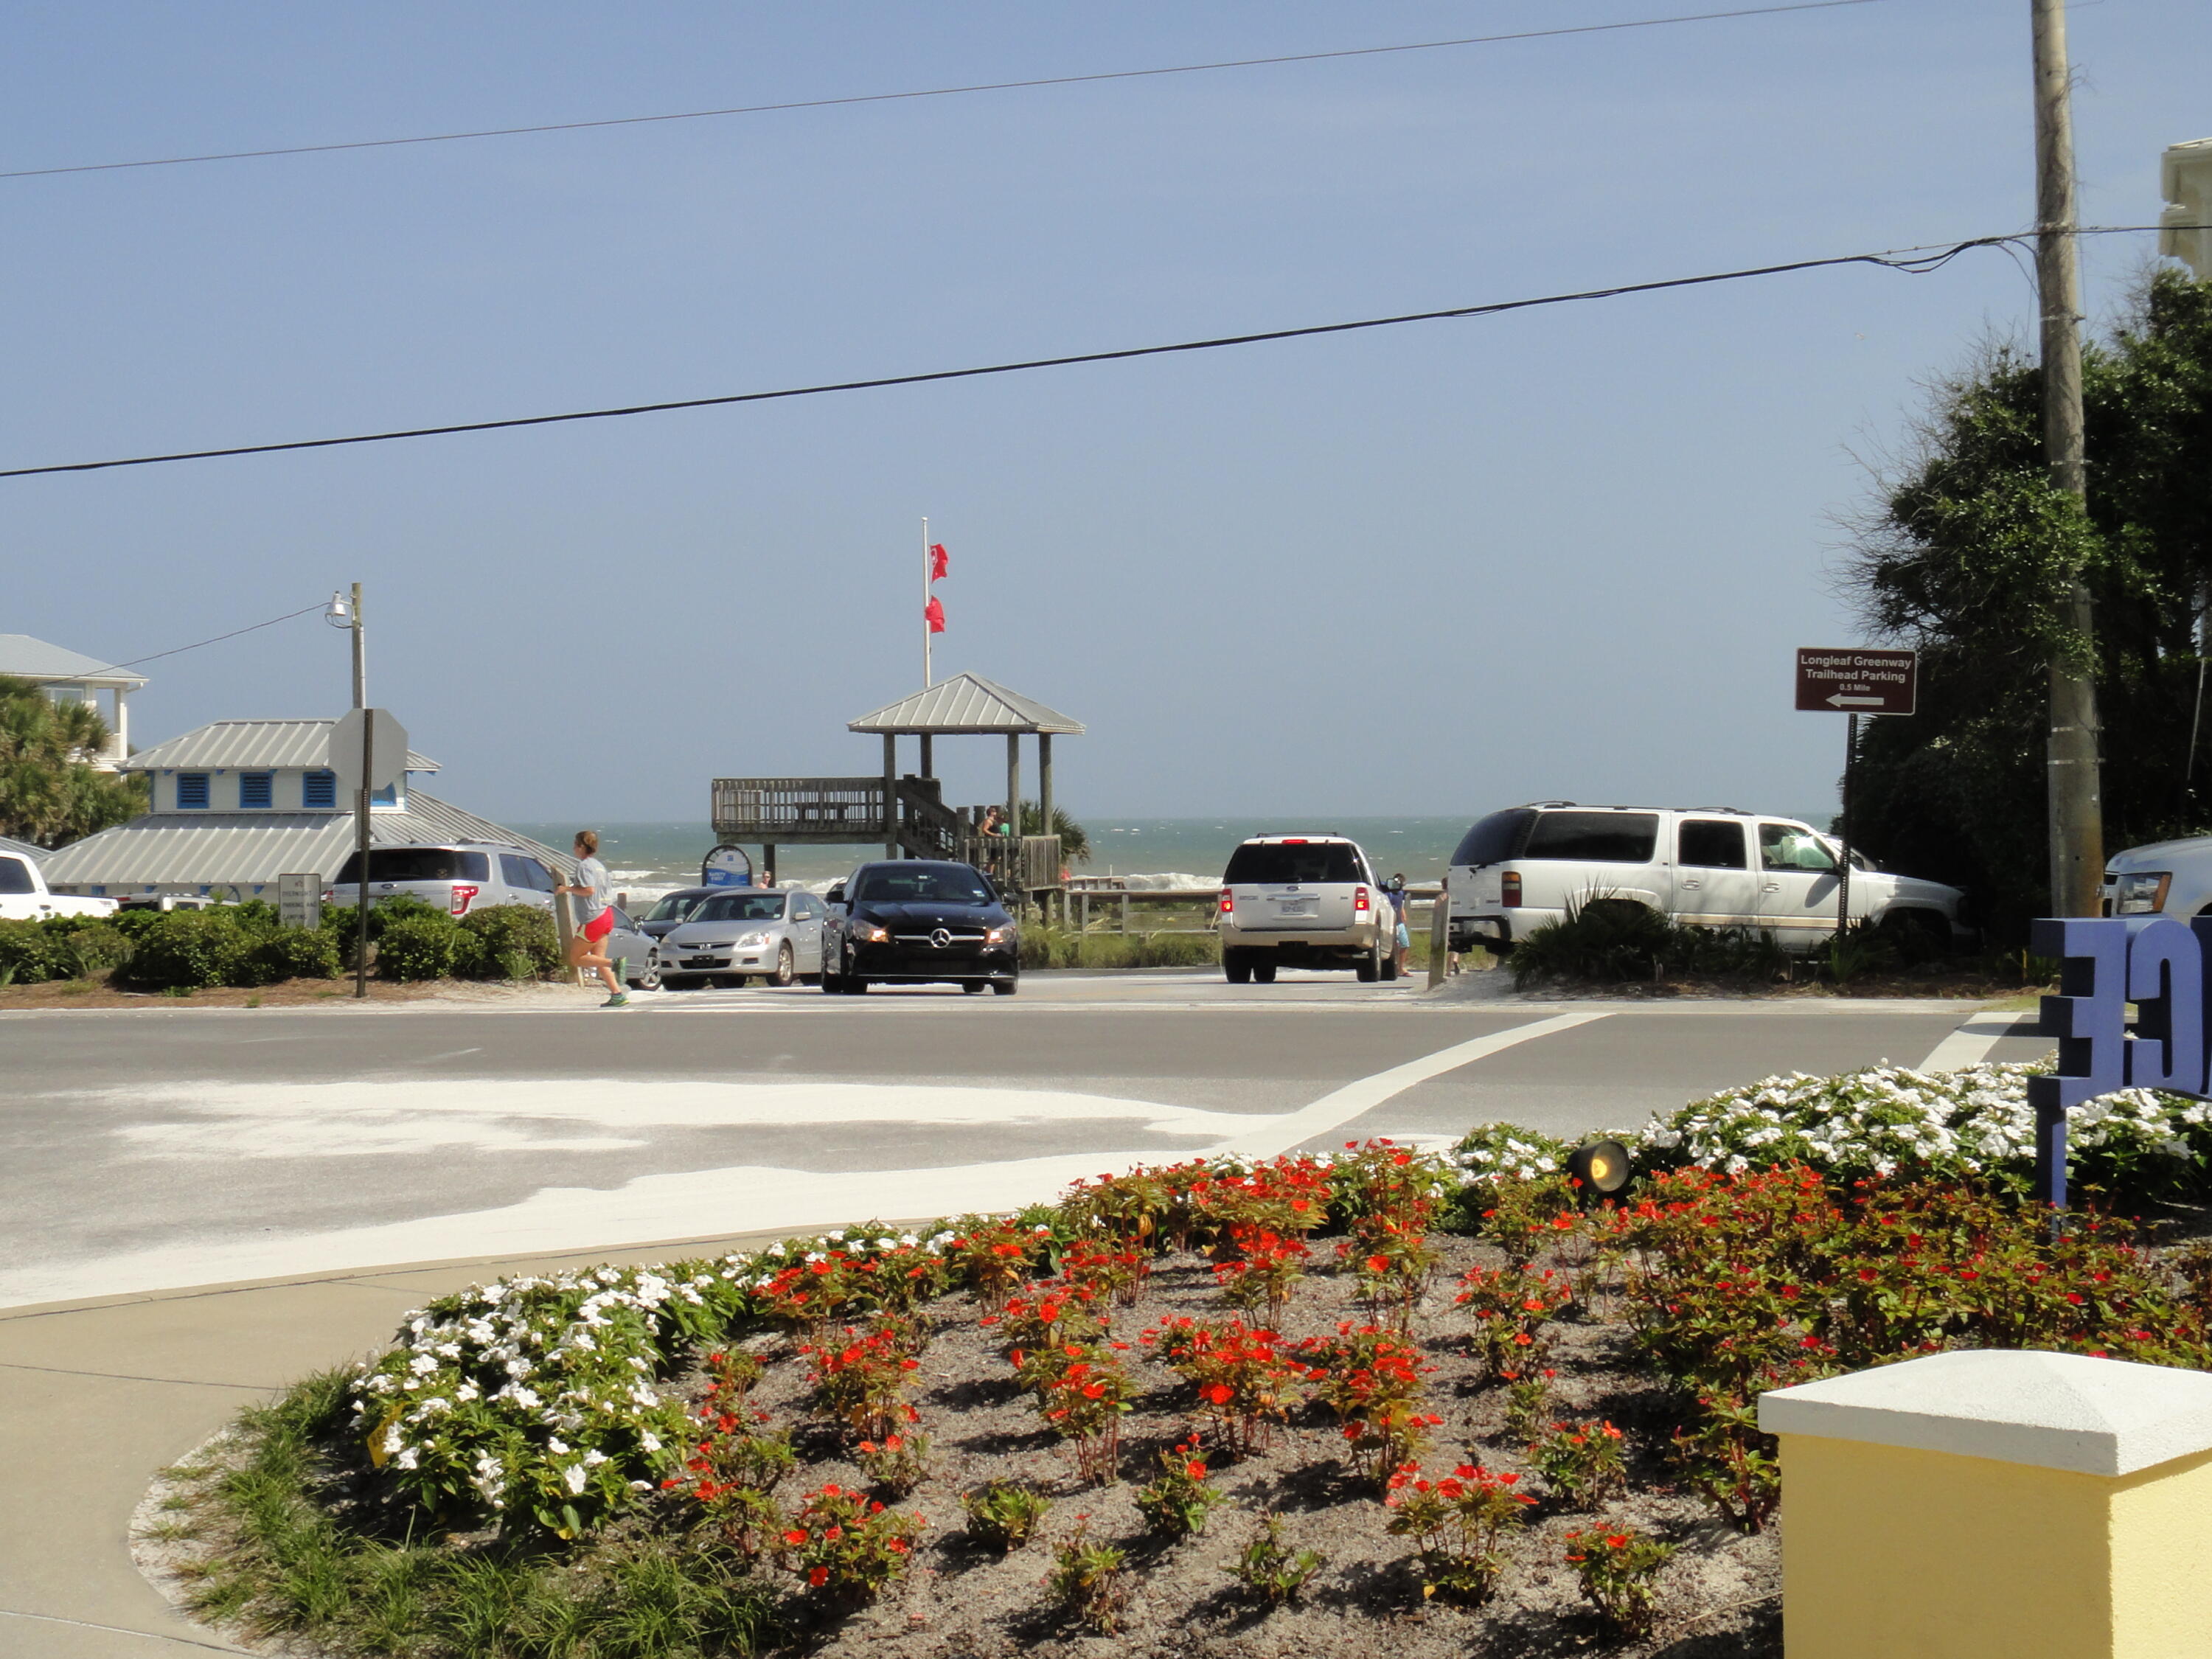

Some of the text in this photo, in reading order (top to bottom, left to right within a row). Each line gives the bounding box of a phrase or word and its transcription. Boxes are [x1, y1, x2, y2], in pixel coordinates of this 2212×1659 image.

[1801, 655, 1912, 669] Longleaf Greenway
[1806, 669, 1906, 684] Trailhead Parking
